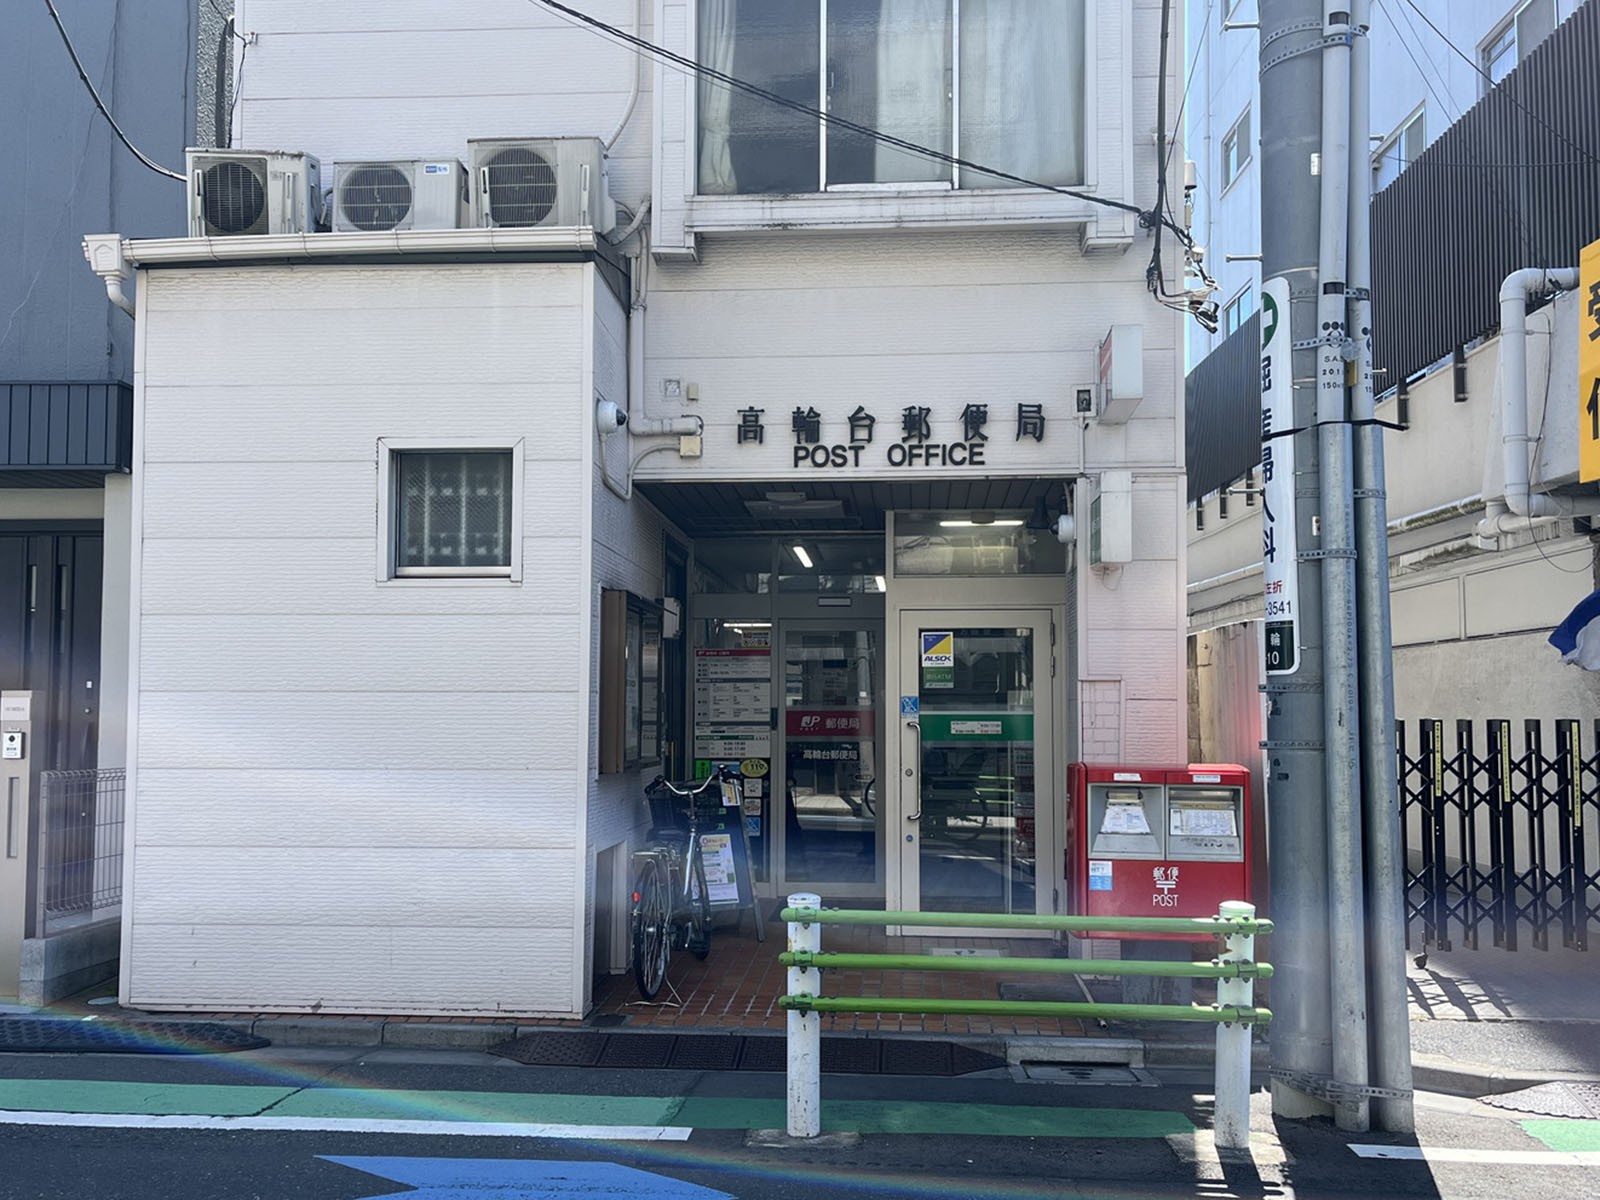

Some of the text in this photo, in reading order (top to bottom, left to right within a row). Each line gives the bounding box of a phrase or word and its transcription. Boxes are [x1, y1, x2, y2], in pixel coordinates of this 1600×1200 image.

[736, 402, 1046, 444] 高輪台郵便局
[793, 442, 986, 468] POST OFFICE
[826, 717, 860, 730] 郵便局
[1152, 866, 1179, 882] 郵便
[1152, 894, 1179, 907] POST
